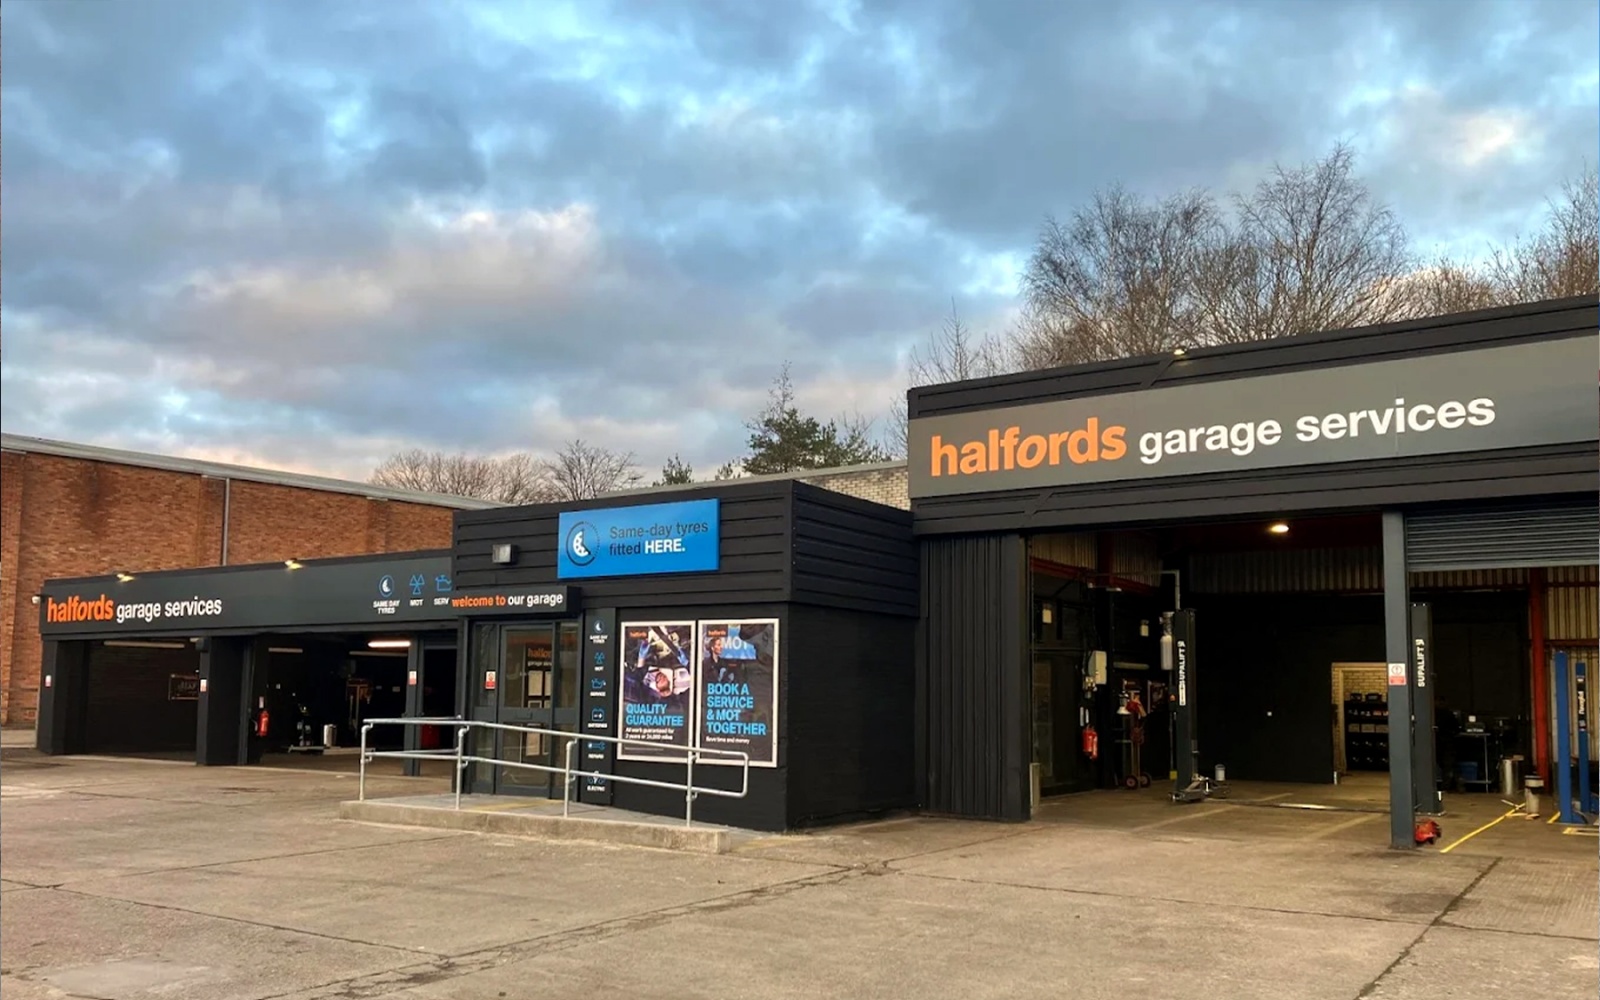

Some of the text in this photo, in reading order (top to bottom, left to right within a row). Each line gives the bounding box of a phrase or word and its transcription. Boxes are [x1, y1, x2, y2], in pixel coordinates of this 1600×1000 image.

[930, 397, 1495, 477] halfords garage services
[609, 521, 709, 539] Same-day tyres
[609, 538, 686, 556] fitted HERE.
[409, 598, 424, 607] MOT
[452, 593, 563, 608] welcome to our garage
[47, 594, 222, 624] halfords garage services
[377, 607, 396, 615] TYRES
[1416, 646, 1426, 688] SUPALIFT
[707, 683, 749, 696] BOOK A
[626, 703, 667, 715] QUALITY
[706, 696, 754, 709] SERVICE
[625, 715, 684, 727] GUARANTEE
[706, 709, 742, 721] & MOT
[706, 721, 767, 736] TOGETHER
